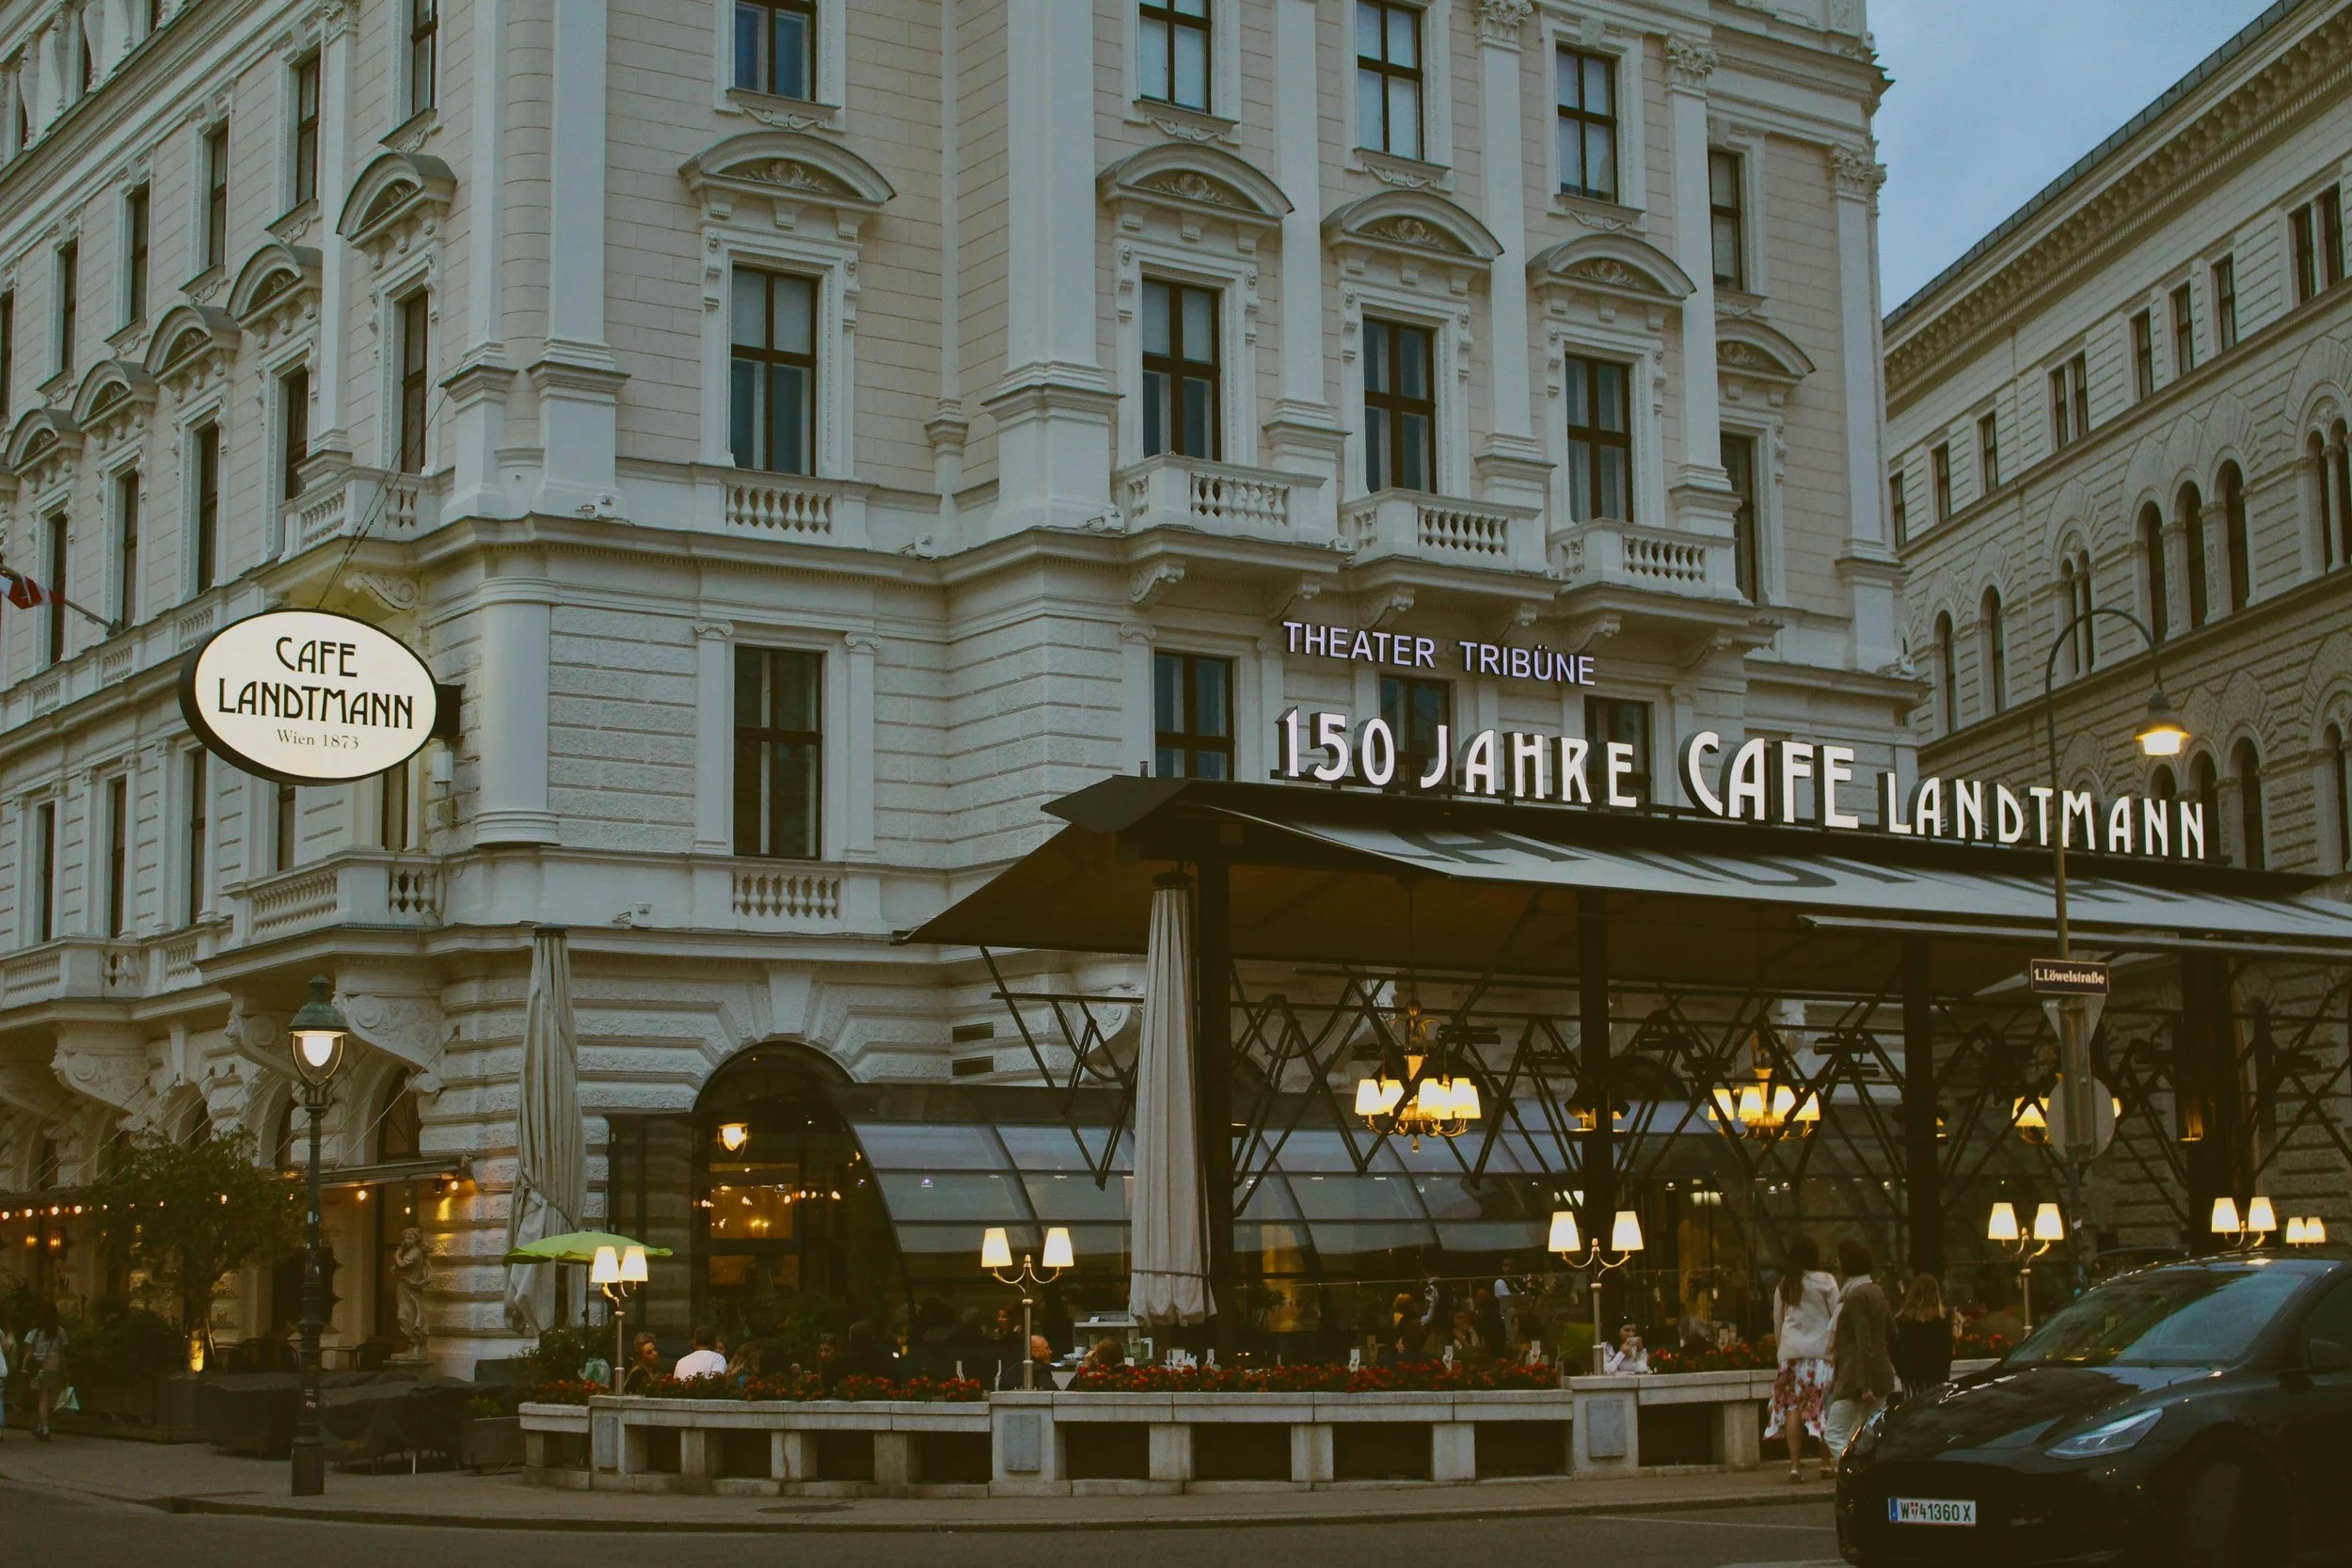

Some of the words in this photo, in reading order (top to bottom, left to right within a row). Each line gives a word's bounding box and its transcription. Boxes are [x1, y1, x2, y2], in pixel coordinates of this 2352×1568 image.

[276, 636, 358, 678] CAFE
[1282, 621, 1437, 669] THEATER
[1459, 641, 1597, 687] TRIBÜNE
[217, 677, 413, 730] LANDTMANN
[277, 729, 316, 746] Wien
[322, 734, 359, 751] 1873
[1281, 708, 1396, 786] 150
[1420, 724, 1638, 809] JAHRE
[1687, 730, 1860, 830] CAFE
[1885, 771, 2206, 860] LANDTMANN
